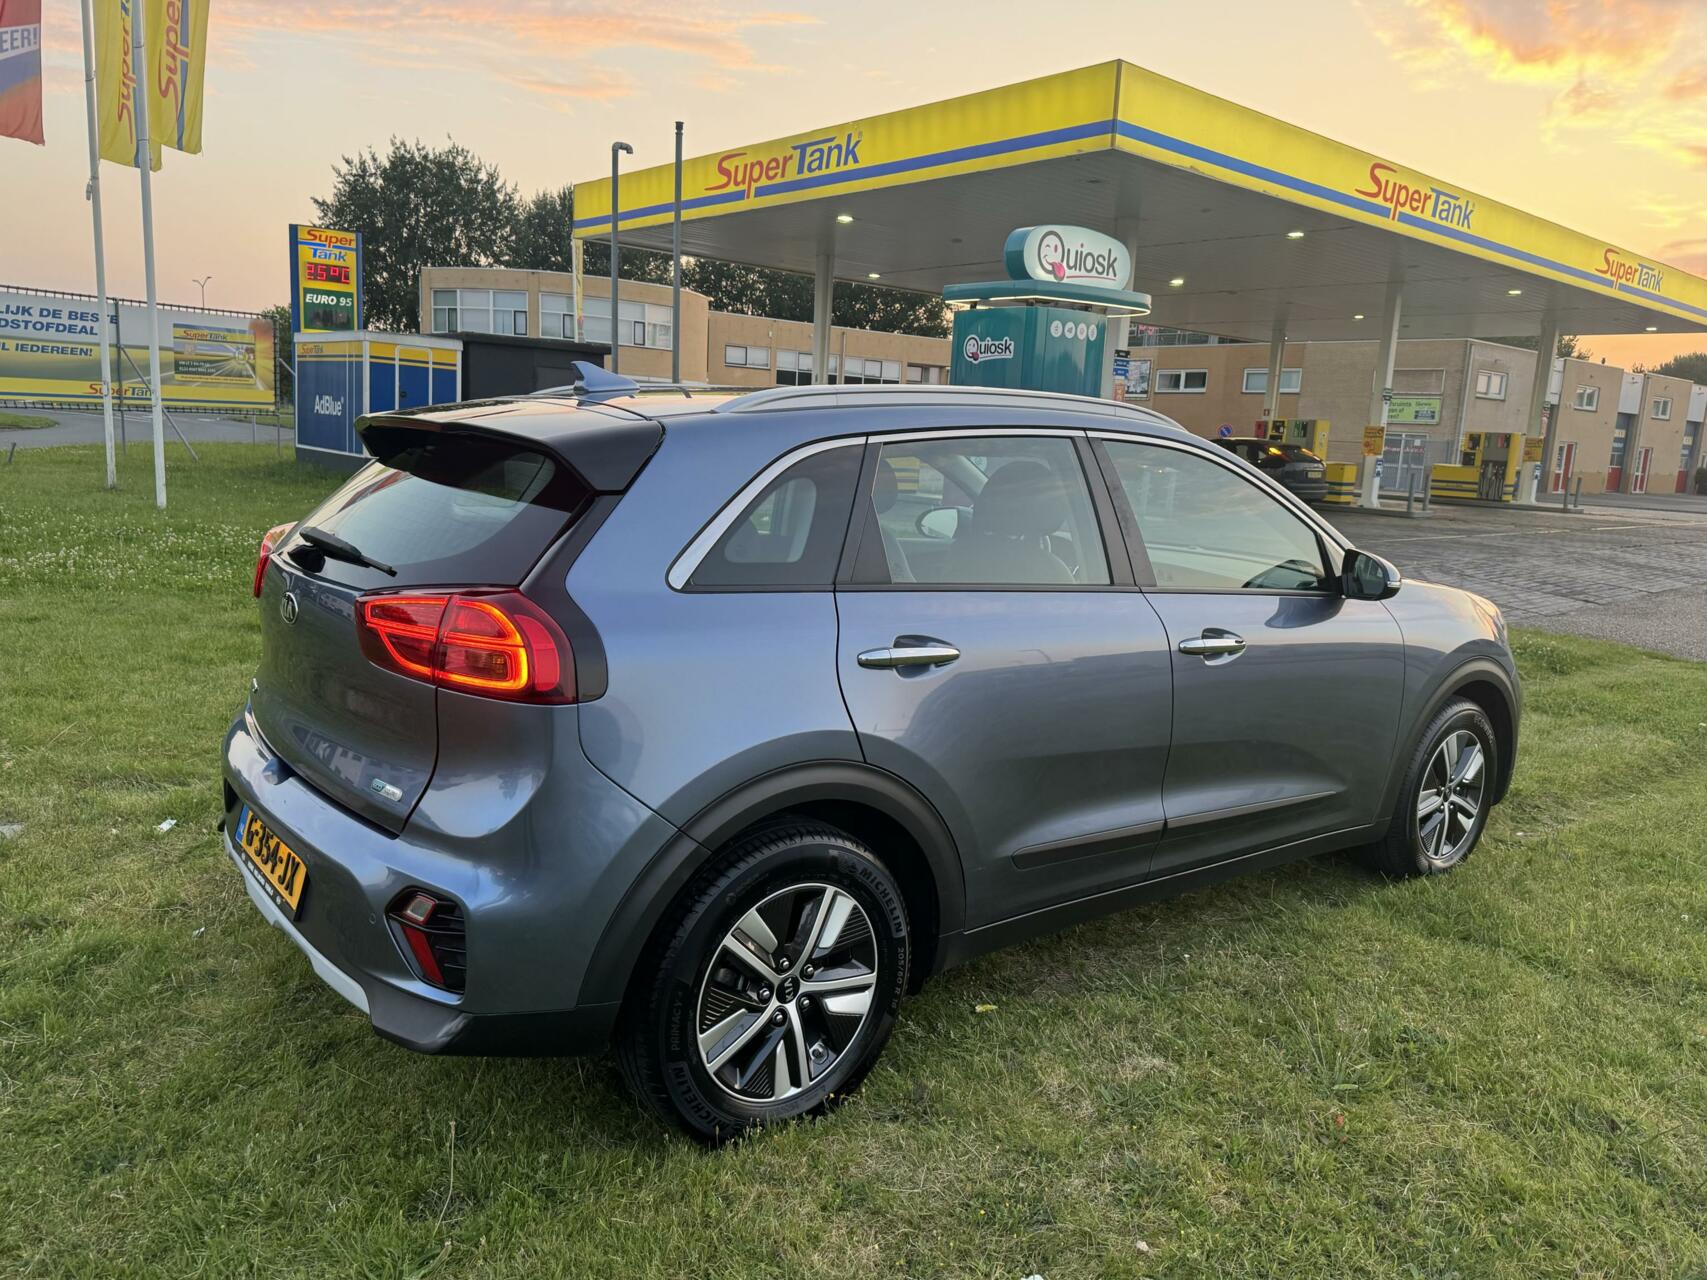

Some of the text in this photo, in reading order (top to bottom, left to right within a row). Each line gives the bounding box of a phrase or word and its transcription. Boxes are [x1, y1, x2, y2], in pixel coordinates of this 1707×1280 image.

[704, 133, 863, 200] SuperTank
[1354, 162, 1474, 229] SuperTank
[300, 228, 355, 248] Super
[308, 247, 347, 262] Tank
[1037, 230, 1118, 281] Quiosk
[1594, 248, 1664, 292] SuperTank
[305, 294, 352, 307] EURO 95
[39, 307, 62, 320] DE
[68, 310, 119, 325] BESE
[15, 343, 93, 357] IEDEREEN!
[965, 336, 1012, 361] Quiosk
[314, 394, 342, 416] AdBlue
[246, 814, 300, 896] G-354-JX
[859, 863, 904, 934] MICHELIN
[784, 977, 794, 1002] KIA
